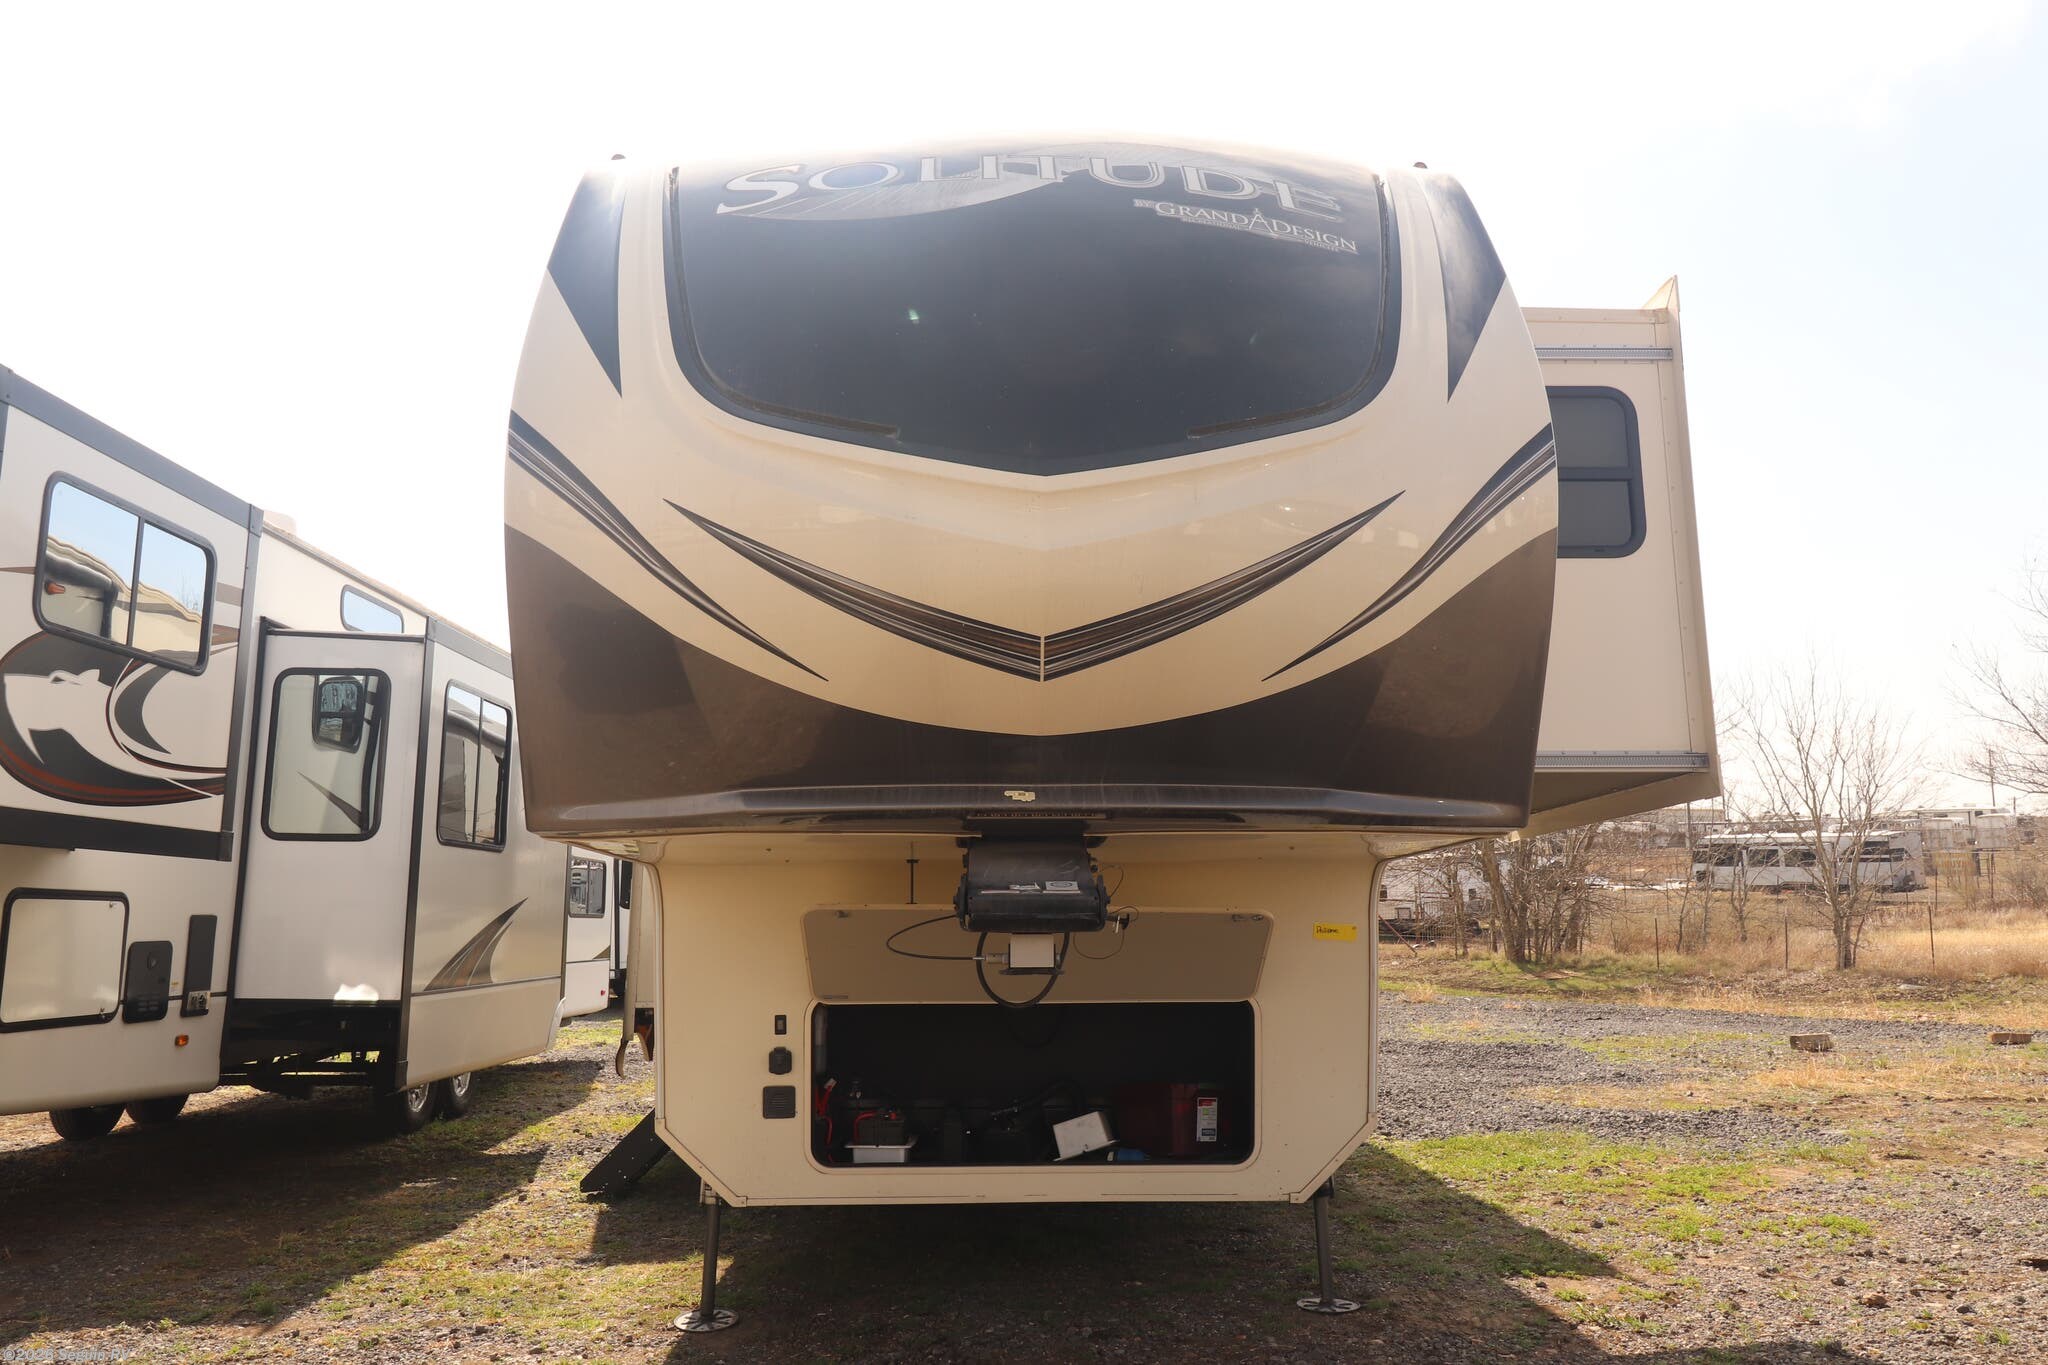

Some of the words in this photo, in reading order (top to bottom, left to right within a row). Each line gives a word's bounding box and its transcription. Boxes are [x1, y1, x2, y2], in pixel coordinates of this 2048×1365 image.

[715, 153, 1343, 222] SOLITUDE
[1133, 199, 1153, 208] BY
[1155, 202, 1249, 225] GRAND
[1272, 219, 1359, 251] DESIGN
